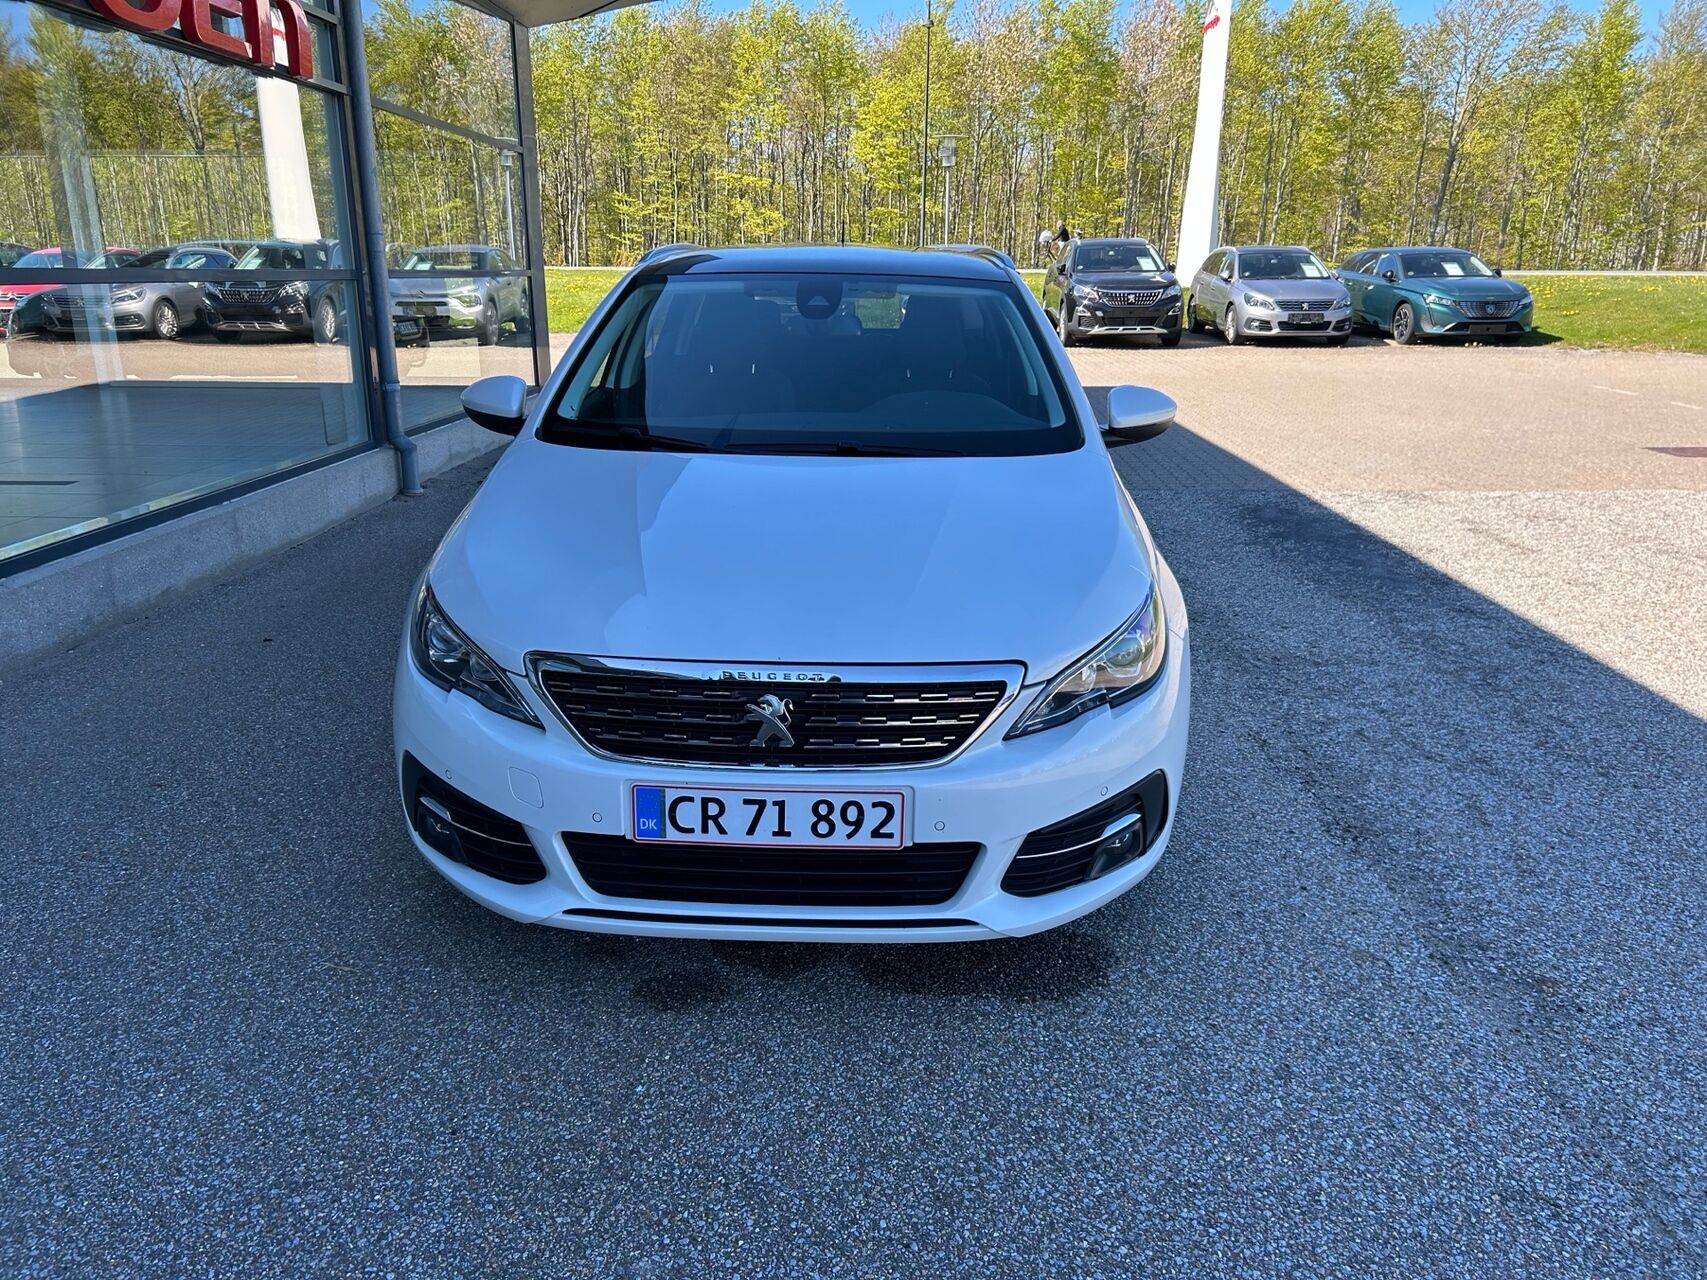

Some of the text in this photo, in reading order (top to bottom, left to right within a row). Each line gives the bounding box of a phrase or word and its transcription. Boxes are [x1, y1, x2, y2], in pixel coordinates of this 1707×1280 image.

[720, 670, 824, 682] PEUGEOT
[668, 795, 896, 840] CR 71 892
[640, 818, 658, 831] DK
